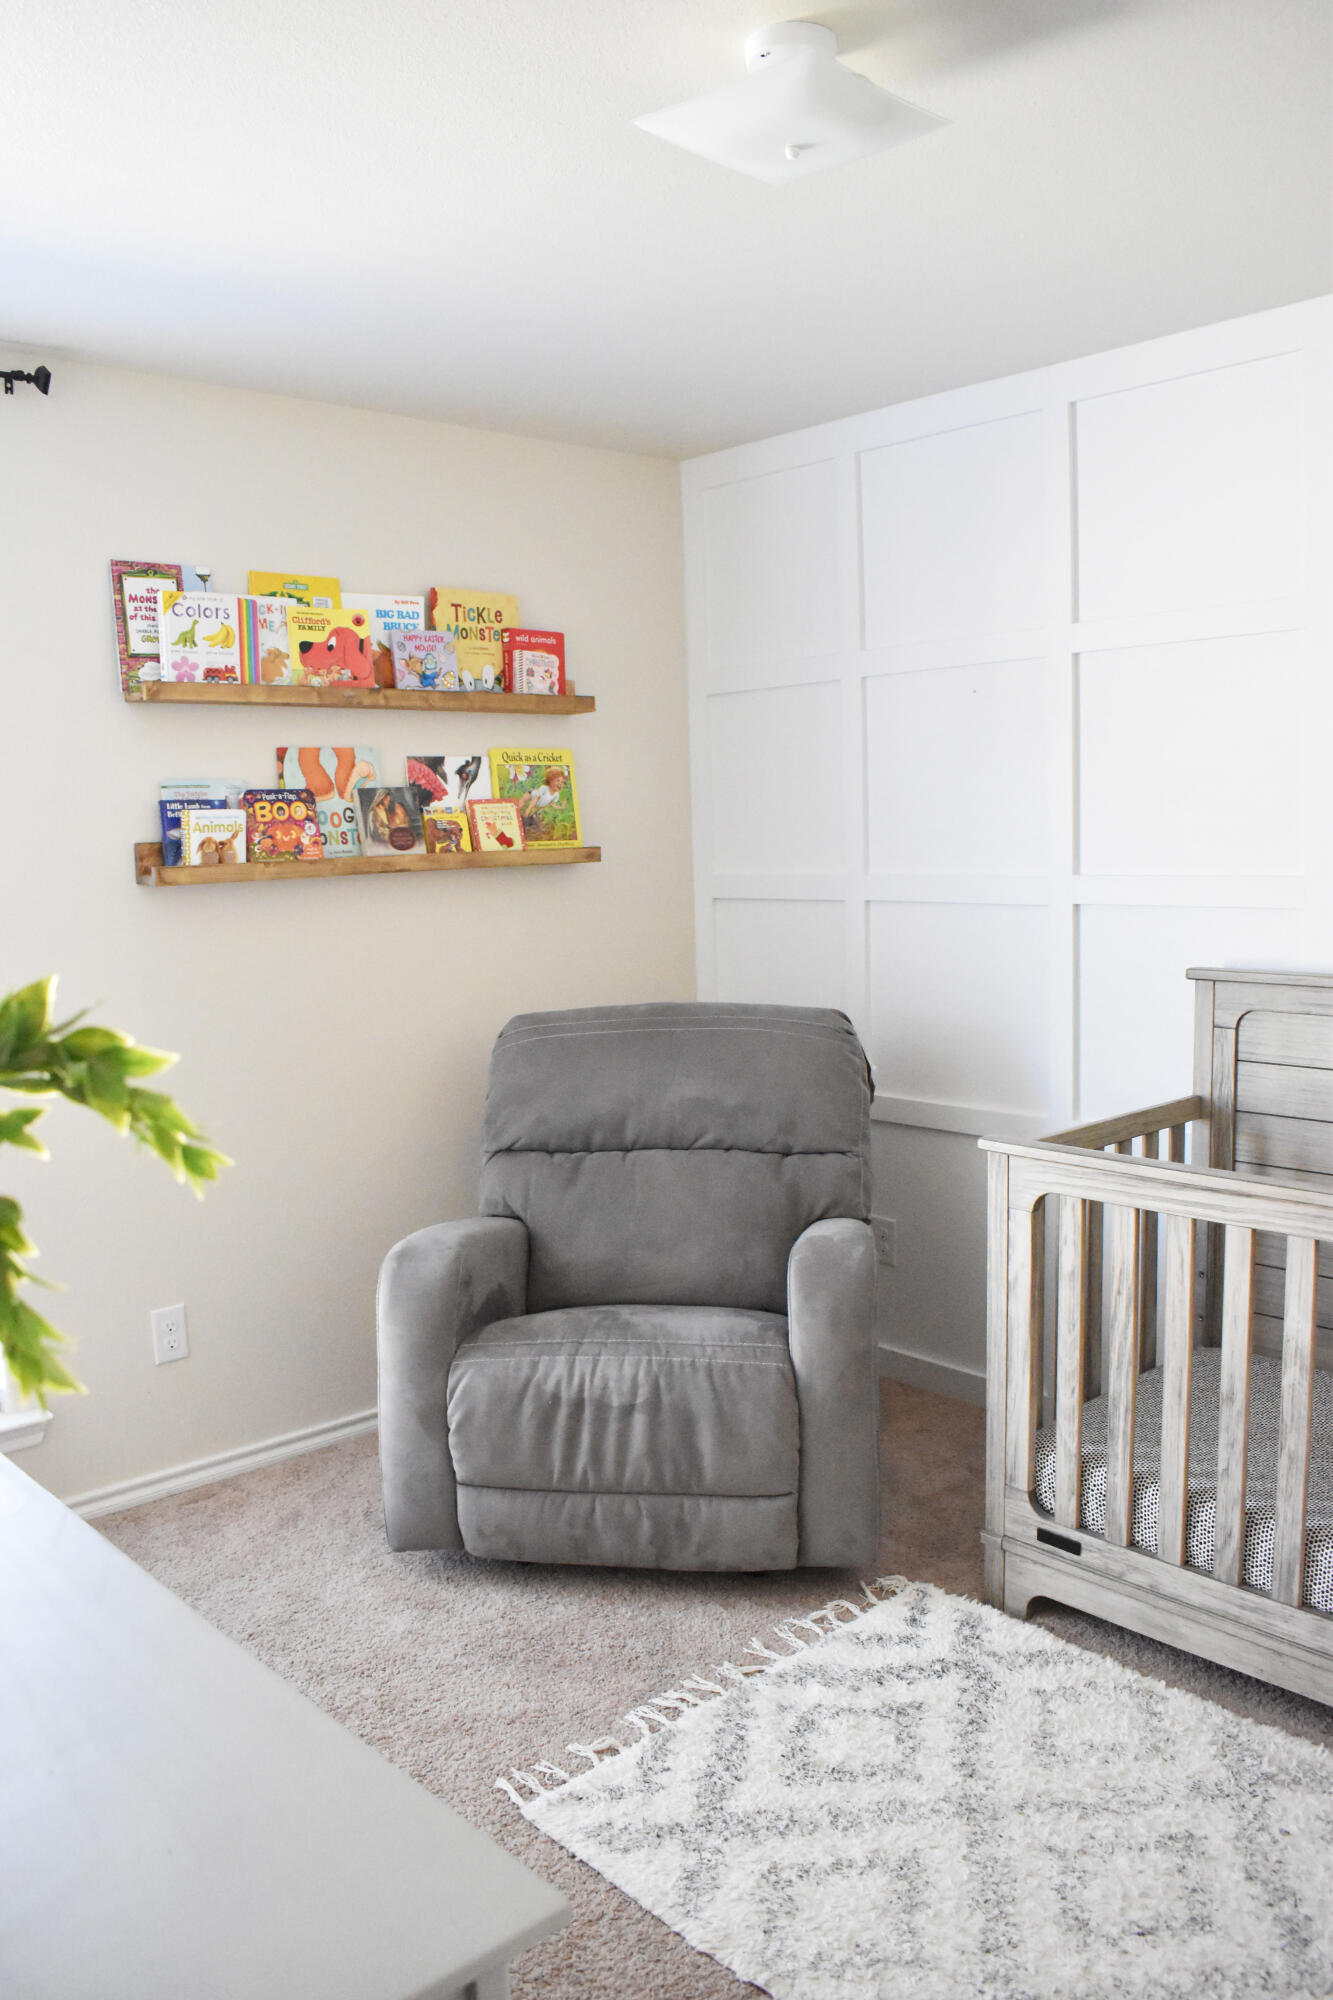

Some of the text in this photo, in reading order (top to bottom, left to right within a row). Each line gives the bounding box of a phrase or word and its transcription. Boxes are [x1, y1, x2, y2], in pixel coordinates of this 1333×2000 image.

[129, 594, 158, 604] MONS
[172, 602, 230, 620] Colors
[376, 609, 420, 620] BIG BAD
[291, 616, 332, 626] Clifford's
[297, 624, 326, 632] FAMILY
[403, 634, 422, 642] HAPPY
[515, 634, 557, 645] wild animals
[501, 751, 523, 764] Quick
[524, 754, 532, 762] as
[537, 751, 562, 762] Cricket
[166, 802, 183, 810] Little
[253, 800, 308, 823] BOO
[193, 820, 244, 833] Animals
